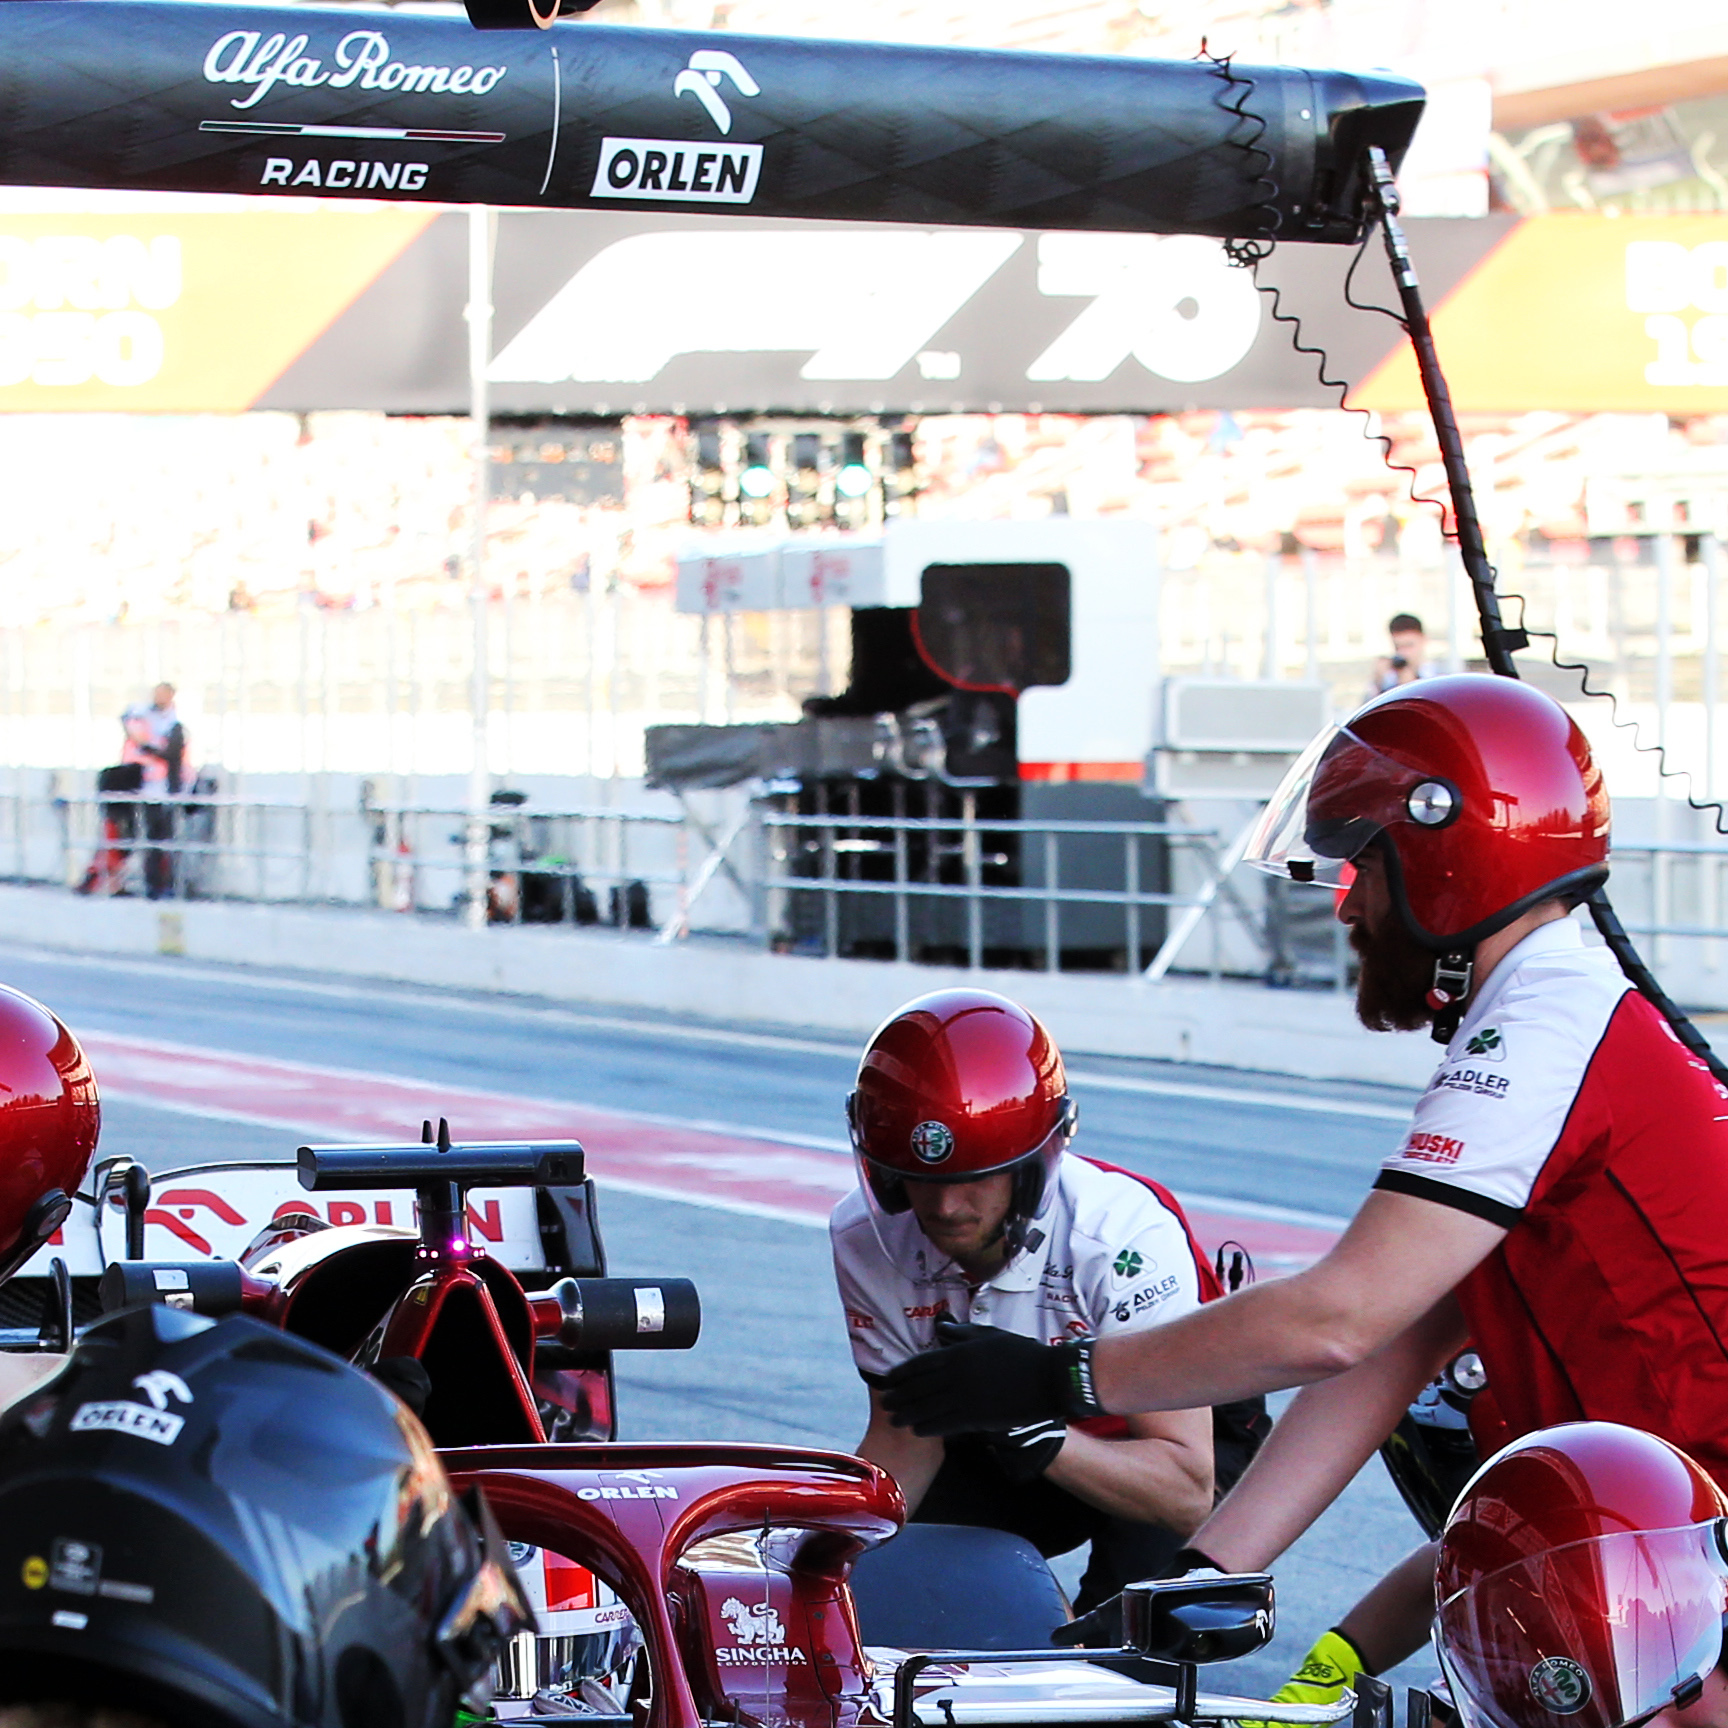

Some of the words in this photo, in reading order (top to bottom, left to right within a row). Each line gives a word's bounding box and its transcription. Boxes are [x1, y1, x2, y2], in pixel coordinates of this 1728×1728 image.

[203, 31, 331, 108] Alfa
[326, 30, 508, 96] Romeo
[260, 157, 430, 191] RACING
[607, 148, 751, 194] ORLEN
[1026, 233, 1261, 383] 70
[1448, 1070, 1510, 1092] ADLER
[1133, 1276, 1178, 1307] ADLER
[576, 1485, 678, 1501] ORLEN
[716, 1647, 805, 1662] SINGHA
